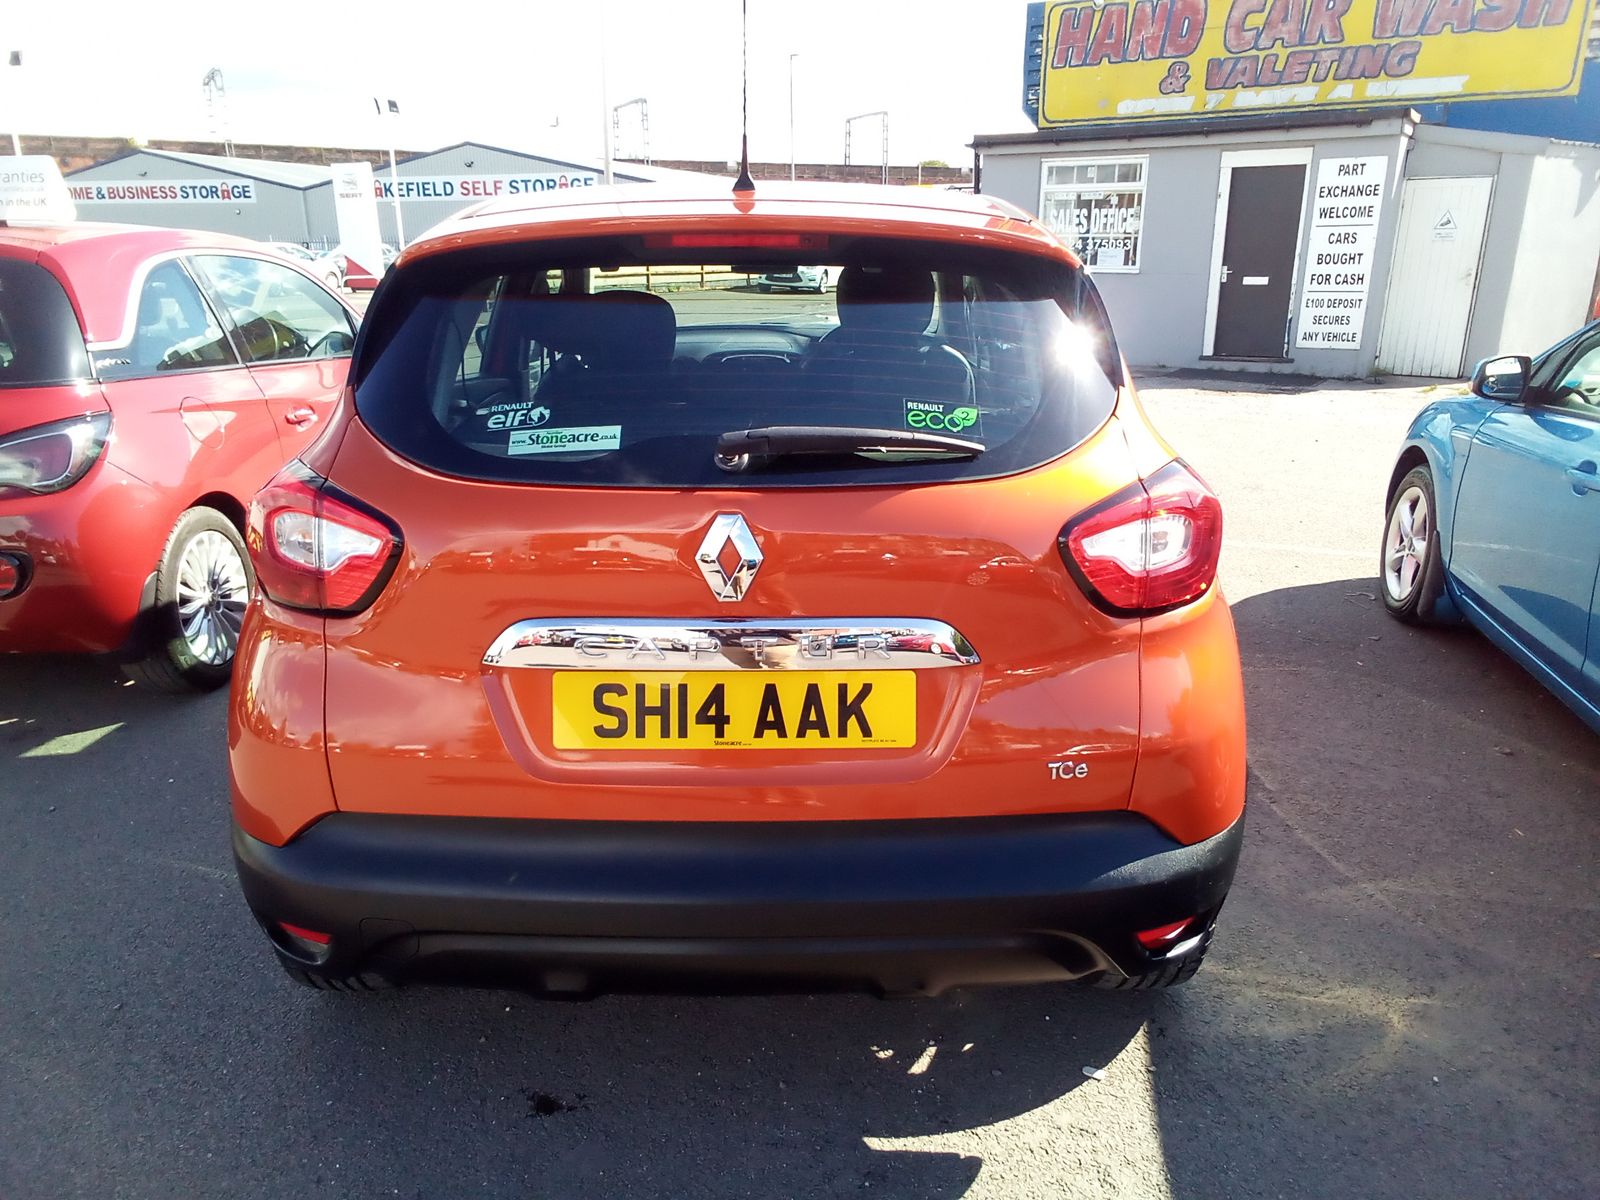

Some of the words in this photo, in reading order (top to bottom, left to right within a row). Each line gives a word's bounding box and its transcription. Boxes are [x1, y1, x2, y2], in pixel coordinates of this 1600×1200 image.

[1050, 0, 1207, 69] HAND
[1224, 0, 1351, 54] CAR
[1159, 61, 1191, 94] &
[1205, 41, 1422, 90] VALETING
[1338, 163, 1367, 176] PART
[0, 171, 46, 183] anties
[96, 186, 106, 200] &
[107, 185, 178, 200] BUSINESS
[180, 181, 251, 200] STORAGE
[460, 180, 503, 196] SELF
[1318, 184, 1380, 198] EXCHANGE
[1319, 206, 1374, 219] WELCOME
[1049, 208, 1088, 234] SALES
[1091, 207, 1135, 234] OFFICE
[1086, 239, 1131, 250] 375093
[1328, 232, 1357, 244] CARS
[1317, 253, 1363, 265] BOUGHT
[1310, 274, 1331, 285] FOR
[1334, 274, 1364, 285] CASH
[1305, 298, 1325, 308] £100
[1327, 298, 1363, 309] DEPOSIT
[1313, 315, 1350, 326] SECURES
[1302, 332, 1319, 342] ANY
[1322, 332, 1357, 342] VEHICLE
[491, 402, 534, 412] RENAULT
[907, 402, 944, 412] RENAULT
[487, 410, 527, 428] elf
[573, 634, 893, 662] CAPTUR
[592, 682, 731, 739] SH14
[753, 682, 873, 739] AAK
[1048, 761, 1088, 780] TCe
